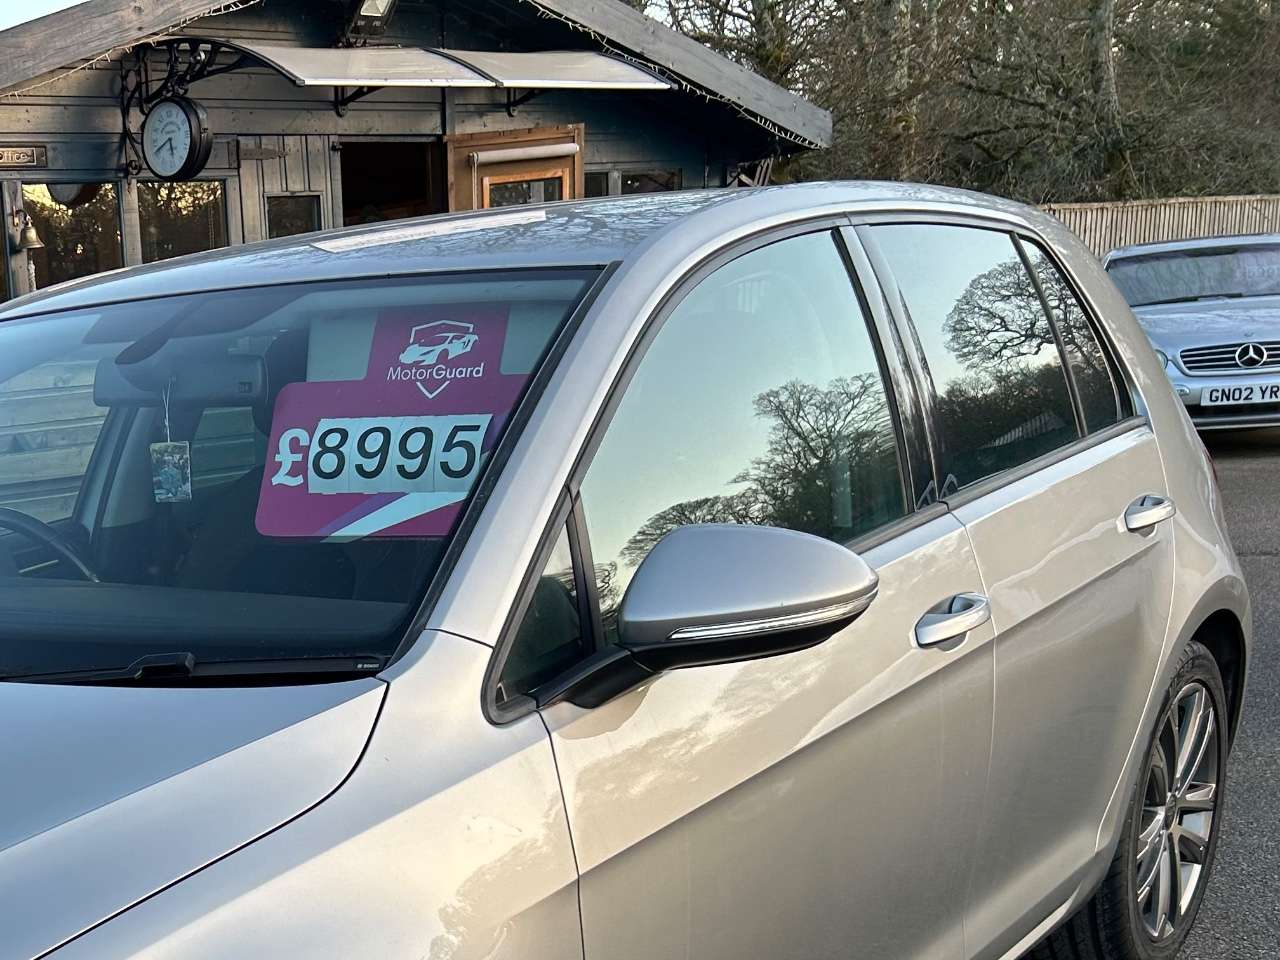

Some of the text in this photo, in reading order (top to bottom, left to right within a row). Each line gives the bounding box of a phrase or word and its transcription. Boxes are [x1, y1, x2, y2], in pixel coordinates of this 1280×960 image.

[387, 363, 484, 381] MotorGuard
[1210, 387, 1253, 403] GN02
[271, 425, 480, 487] £8995
